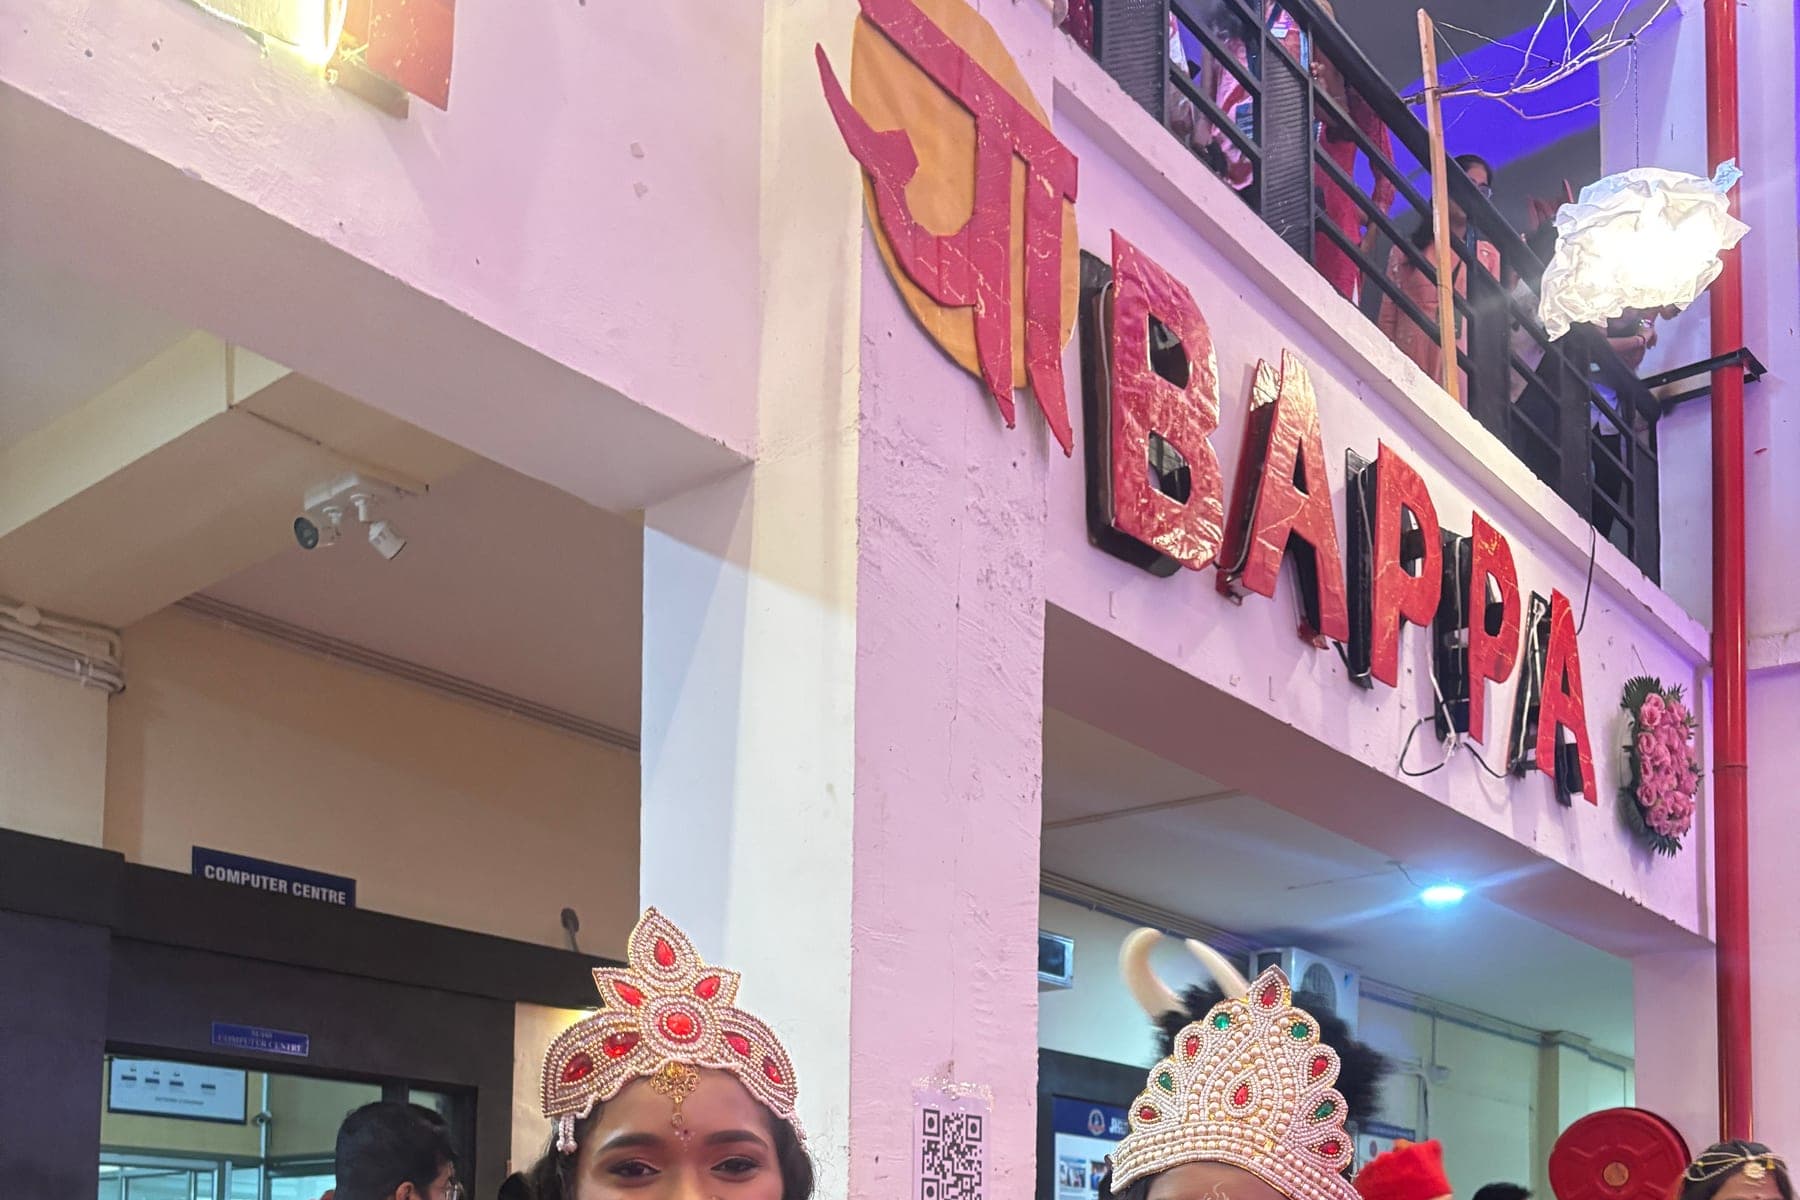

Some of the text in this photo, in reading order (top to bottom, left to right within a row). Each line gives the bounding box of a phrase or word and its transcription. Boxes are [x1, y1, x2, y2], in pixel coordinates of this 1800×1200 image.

[1108, 228, 1598, 807] BAPPA
[204, 864, 346, 906] COMPUTER CENTRE
